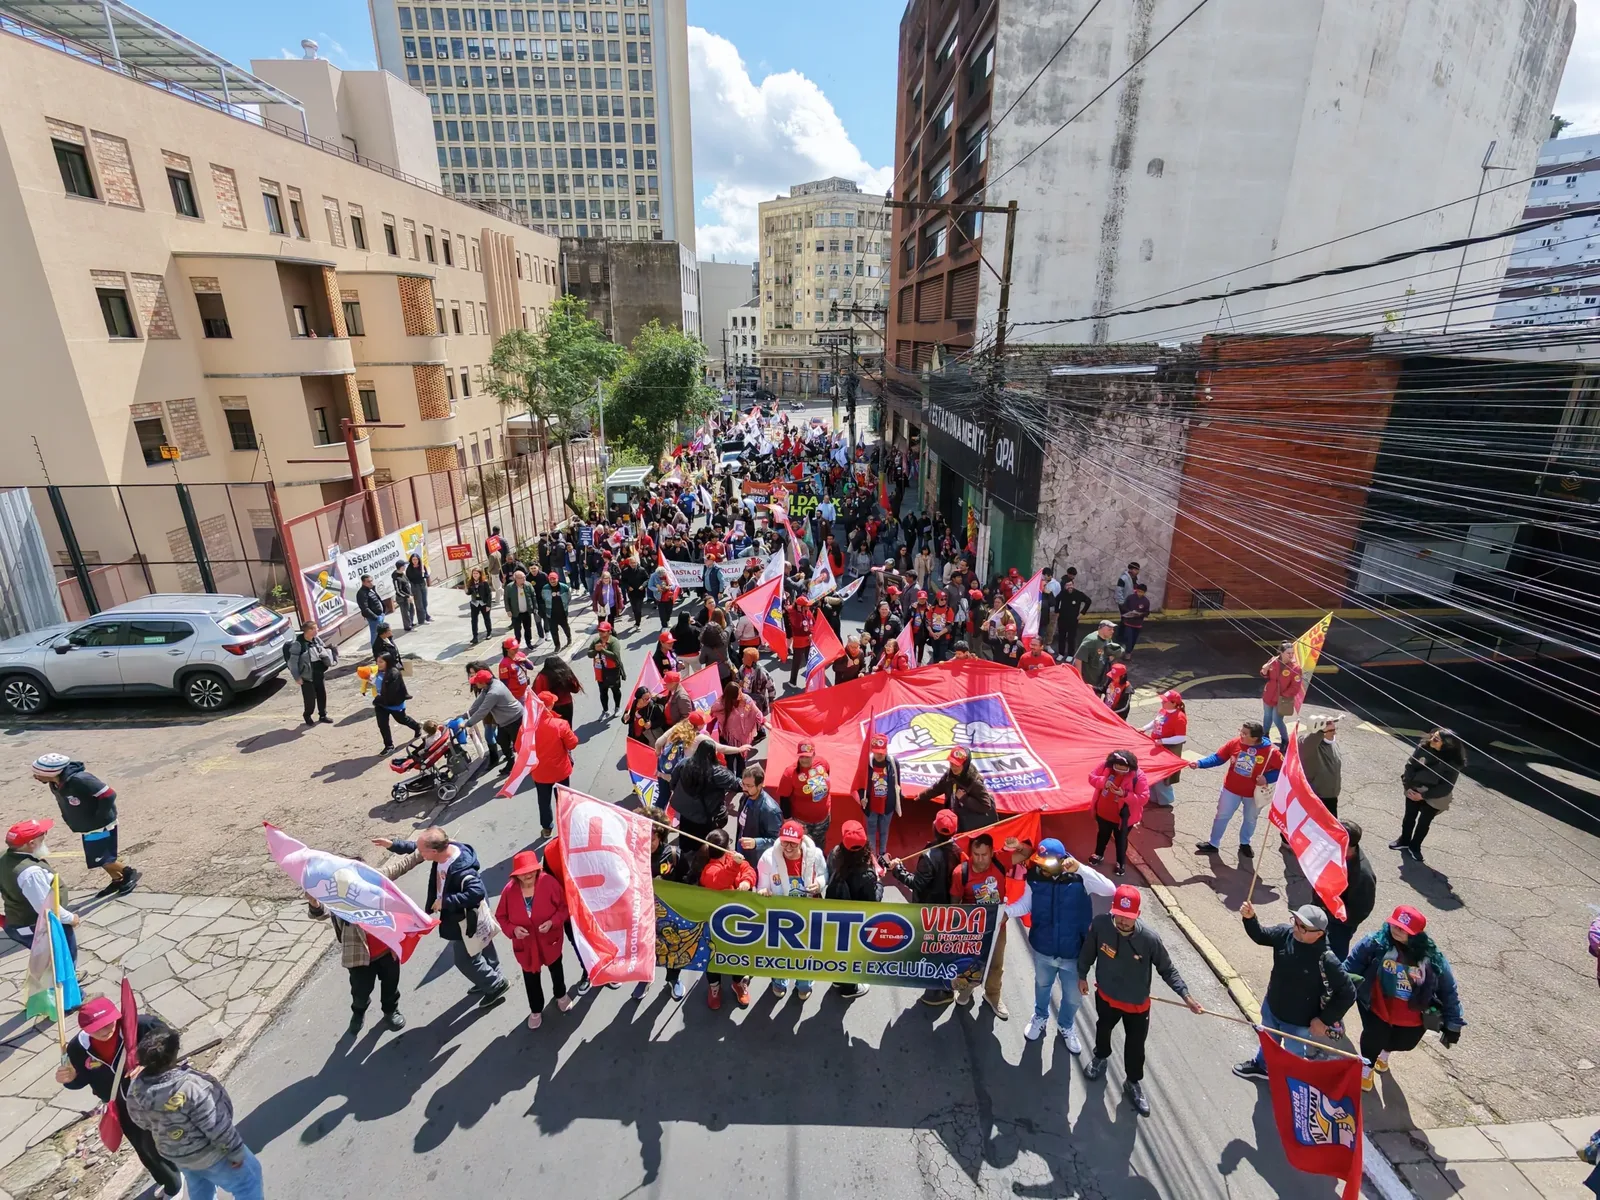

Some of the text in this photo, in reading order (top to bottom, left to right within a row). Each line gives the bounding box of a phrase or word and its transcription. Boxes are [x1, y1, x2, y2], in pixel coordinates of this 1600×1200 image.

[797, 495, 819, 506] DA
[347, 540, 396, 568] ASSENTAMENTO
[347, 571, 357, 581] 20
[357, 566, 368, 576] DE
[370, 549, 400, 571] NOVEMBRO
[783, 828, 798, 838] LULA
[711, 903, 915, 954] GRITO
[920, 906, 987, 933] VIDA
[864, 927, 879, 943] 7
[920, 941, 983, 955] LUGAR!
[715, 952, 958, 979] DOS EXCLUÍDOS E EXCLUÍDAS
[1292, 1090, 1302, 1129] BRASIL
[1310, 1091, 1327, 1142] MNLM
